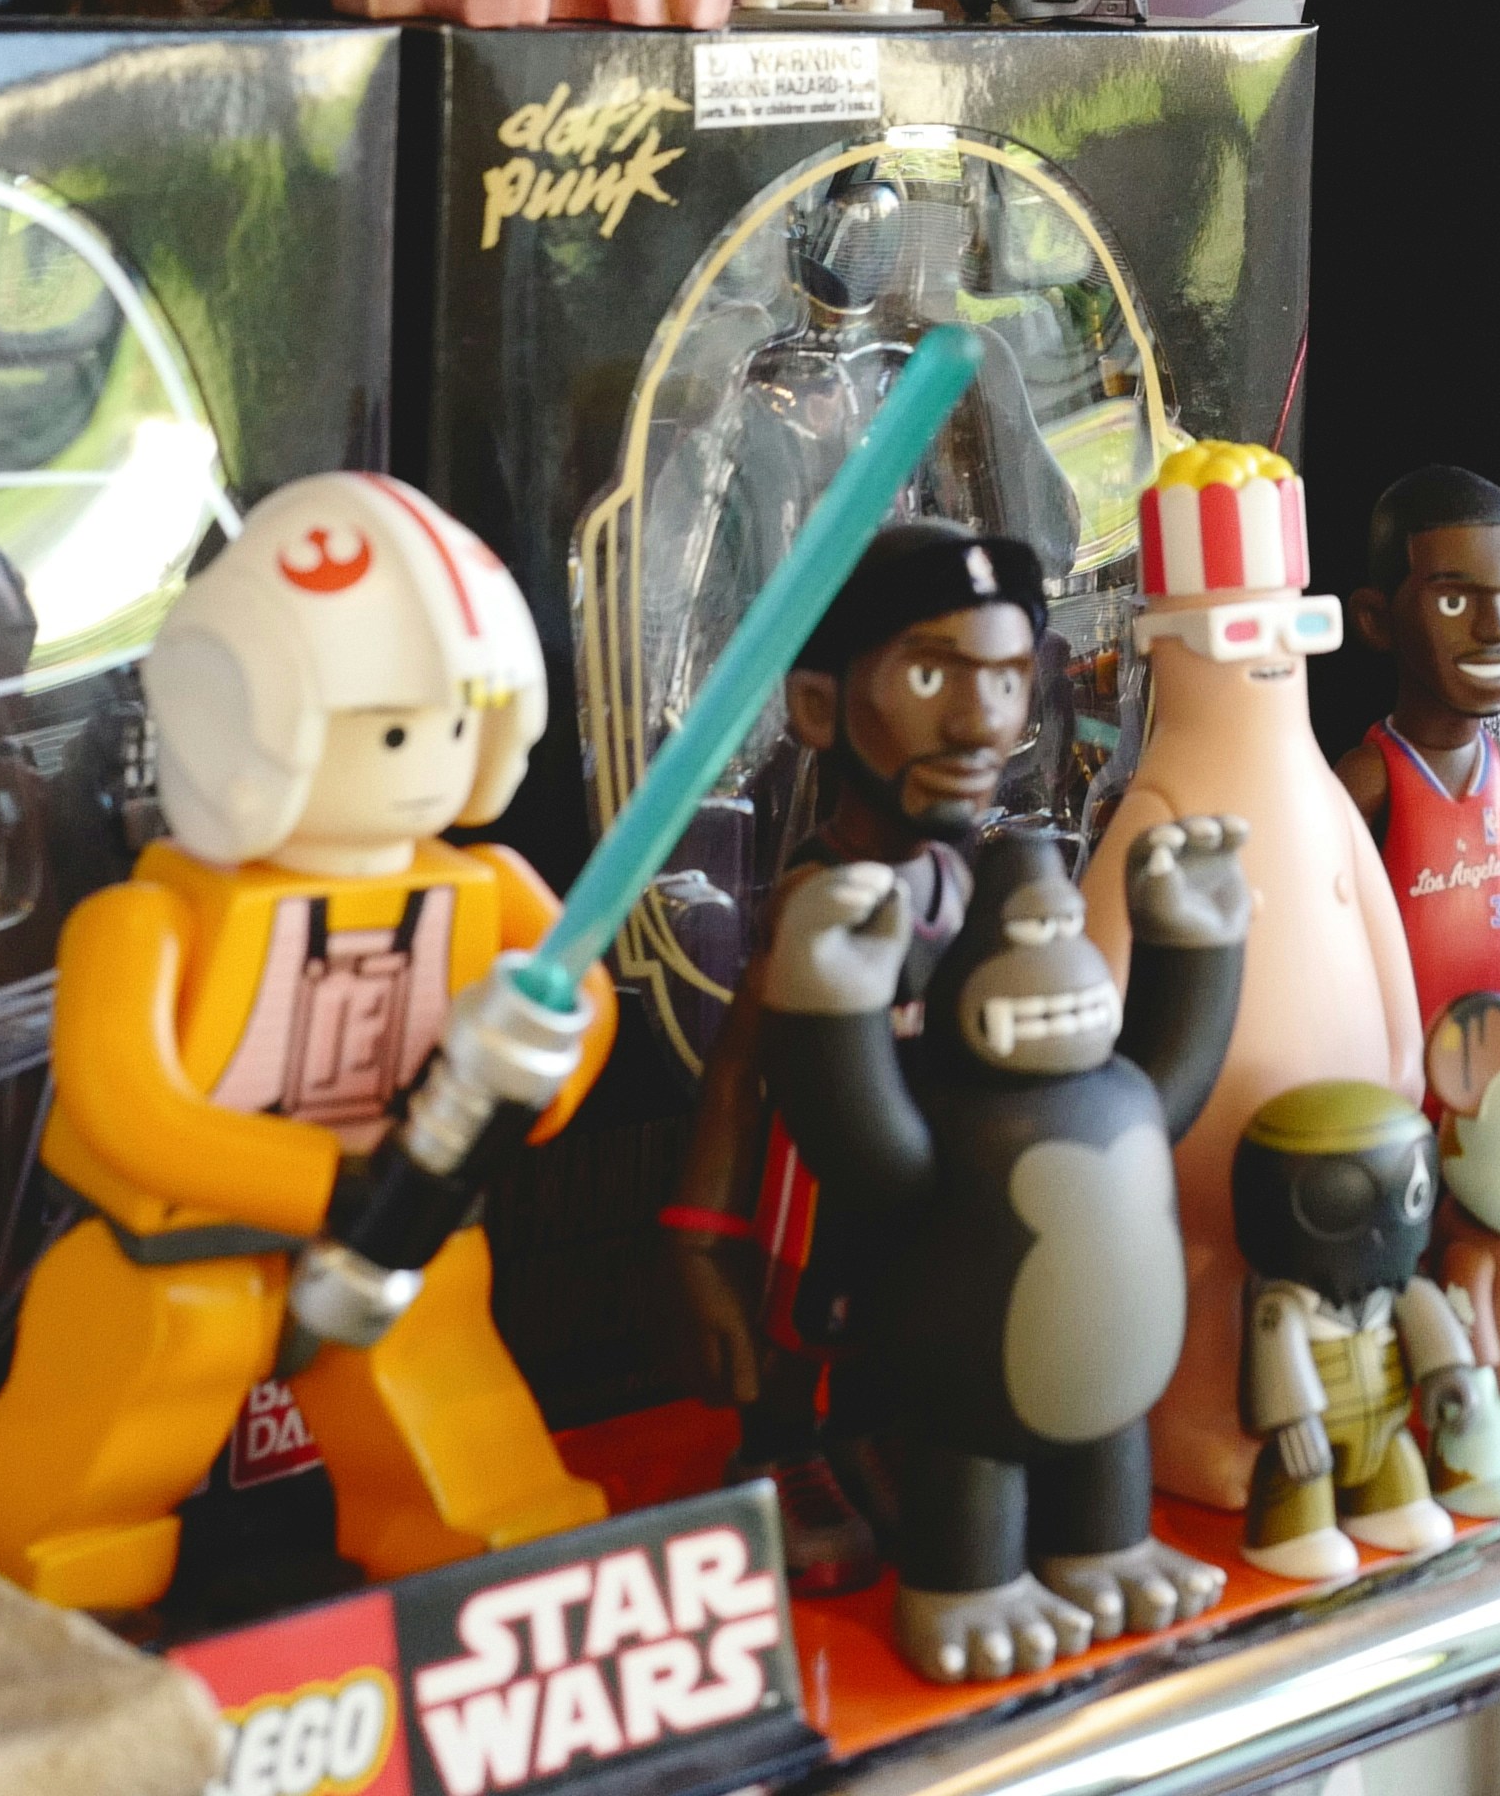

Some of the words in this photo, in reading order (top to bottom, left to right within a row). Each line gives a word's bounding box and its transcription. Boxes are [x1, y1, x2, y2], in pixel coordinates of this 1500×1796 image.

[498, 76, 693, 166] daft
[481, 126, 687, 251] punk
[1409, 867, 1446, 897] Los
[247, 1407, 316, 1461] DA
[412, 1523, 777, 1706] STAR
[419, 1609, 780, 1796] WARS
